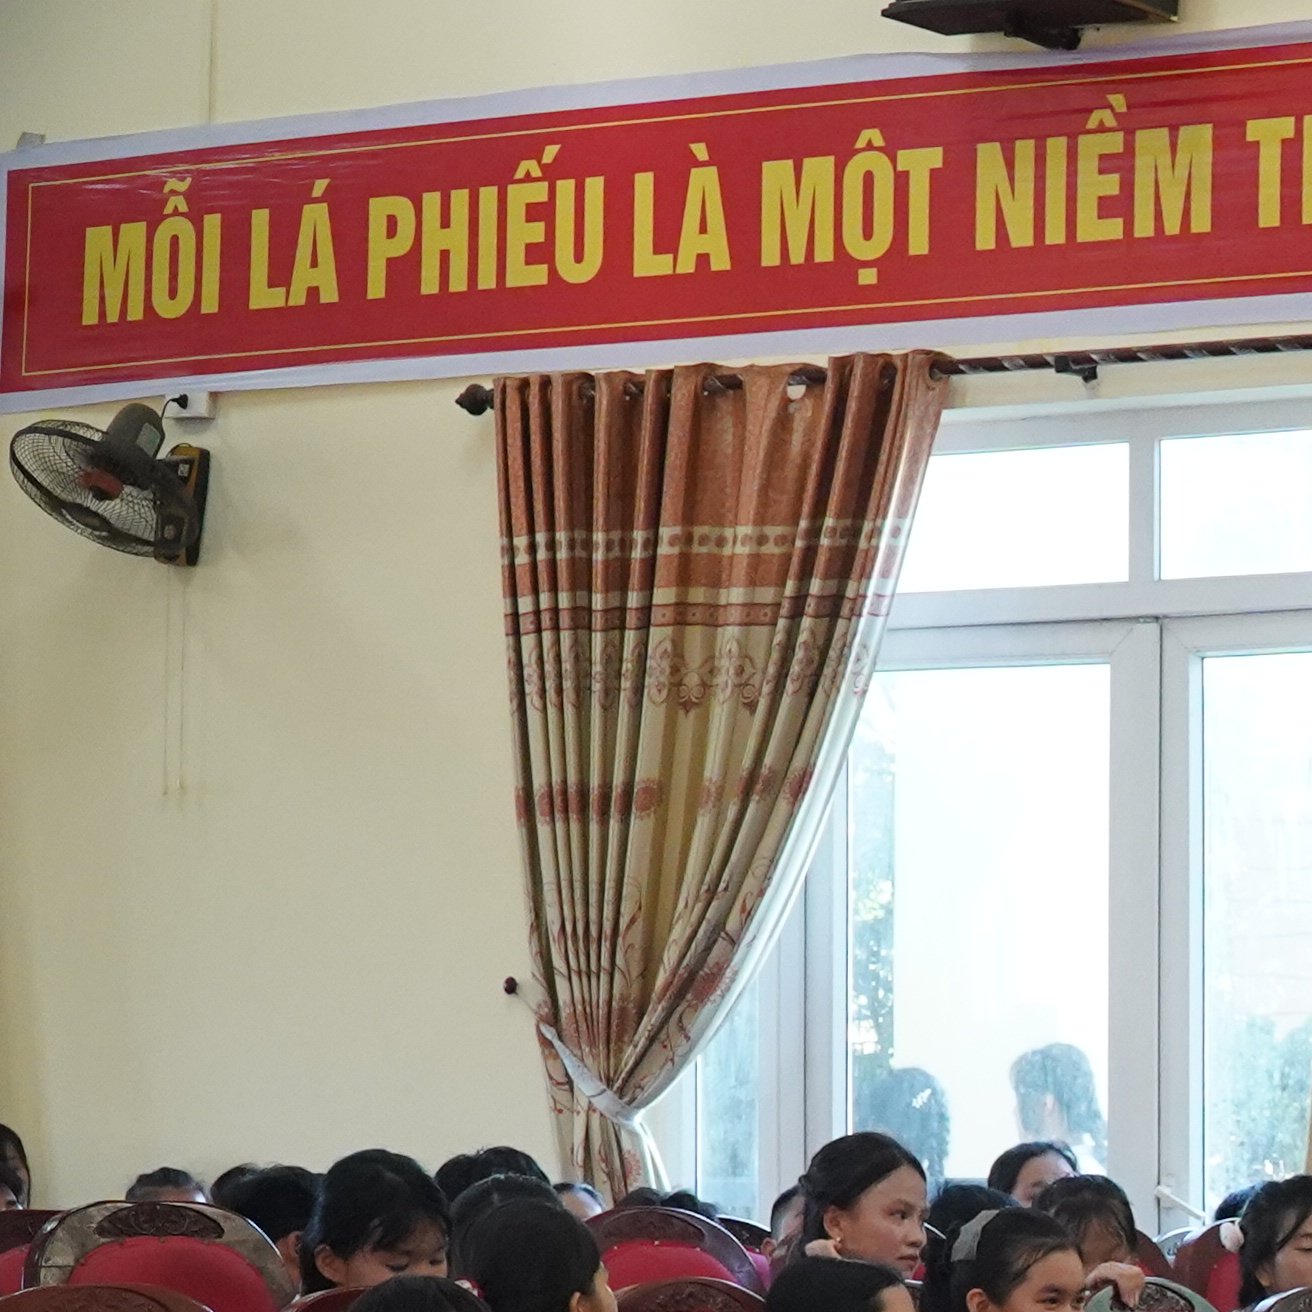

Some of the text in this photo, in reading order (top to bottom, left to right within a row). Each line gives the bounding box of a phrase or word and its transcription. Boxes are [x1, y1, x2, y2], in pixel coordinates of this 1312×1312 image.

[82, 177, 220, 325] MỖI
[249, 179, 338, 310] LÁ
[367, 143, 604, 300] PHIẾU
[633, 142, 731, 276] LÀ
[760, 129, 943, 285] MỘT
[975, 94, 1213, 251] NIỀM
